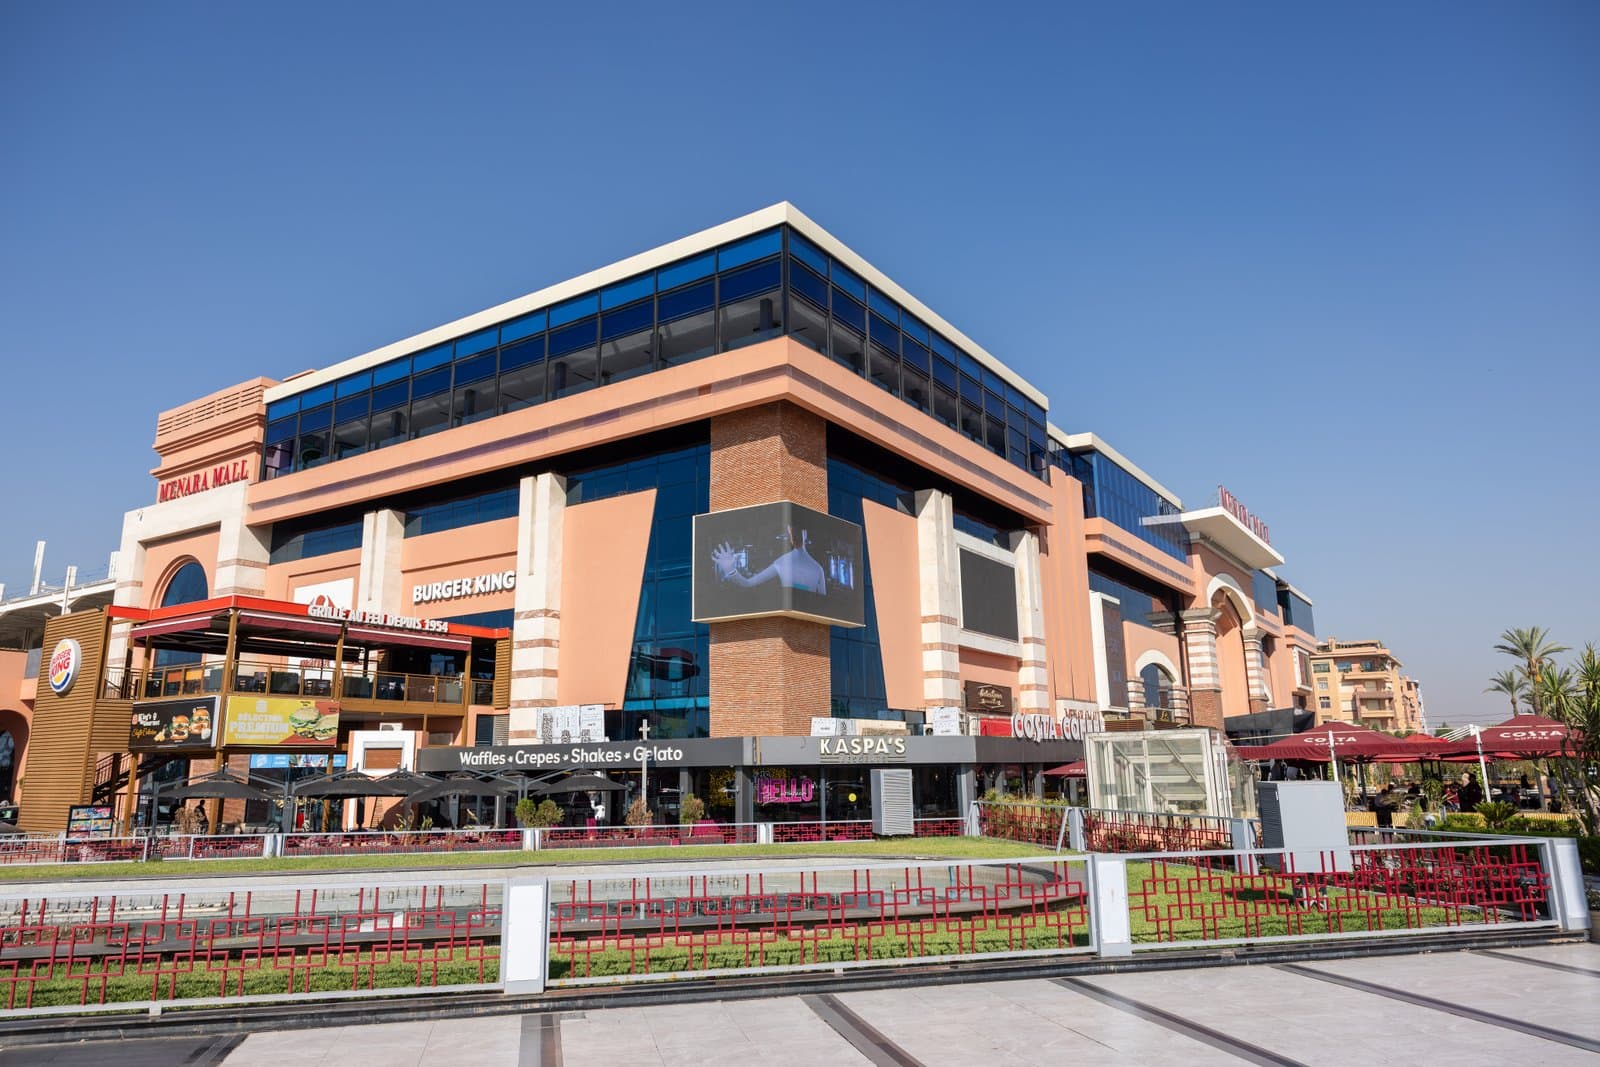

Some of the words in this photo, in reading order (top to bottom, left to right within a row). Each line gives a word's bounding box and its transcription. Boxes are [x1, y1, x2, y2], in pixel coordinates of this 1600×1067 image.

[159, 471, 209, 503] MENARA
[212, 459, 248, 488] MALL
[413, 581, 472, 604] BURGER
[474, 570, 517, 595] KING
[348, 608, 364, 621] AU
[387, 614, 423, 630] DEPUIS
[424, 618, 449, 633] 1954
[51, 656, 71, 678] KING
[1013, 713, 1058, 743] COSTA
[1499, 730, 1563, 738] COSTA
[459, 751, 506, 766] Waffles
[515, 750, 561, 767] Crepes
[571, 748, 622, 763] Shakes
[632, 746, 683, 762] Gelato
[820, 737, 906, 755] KASPA'S
[757, 777, 813, 804] HELLO
